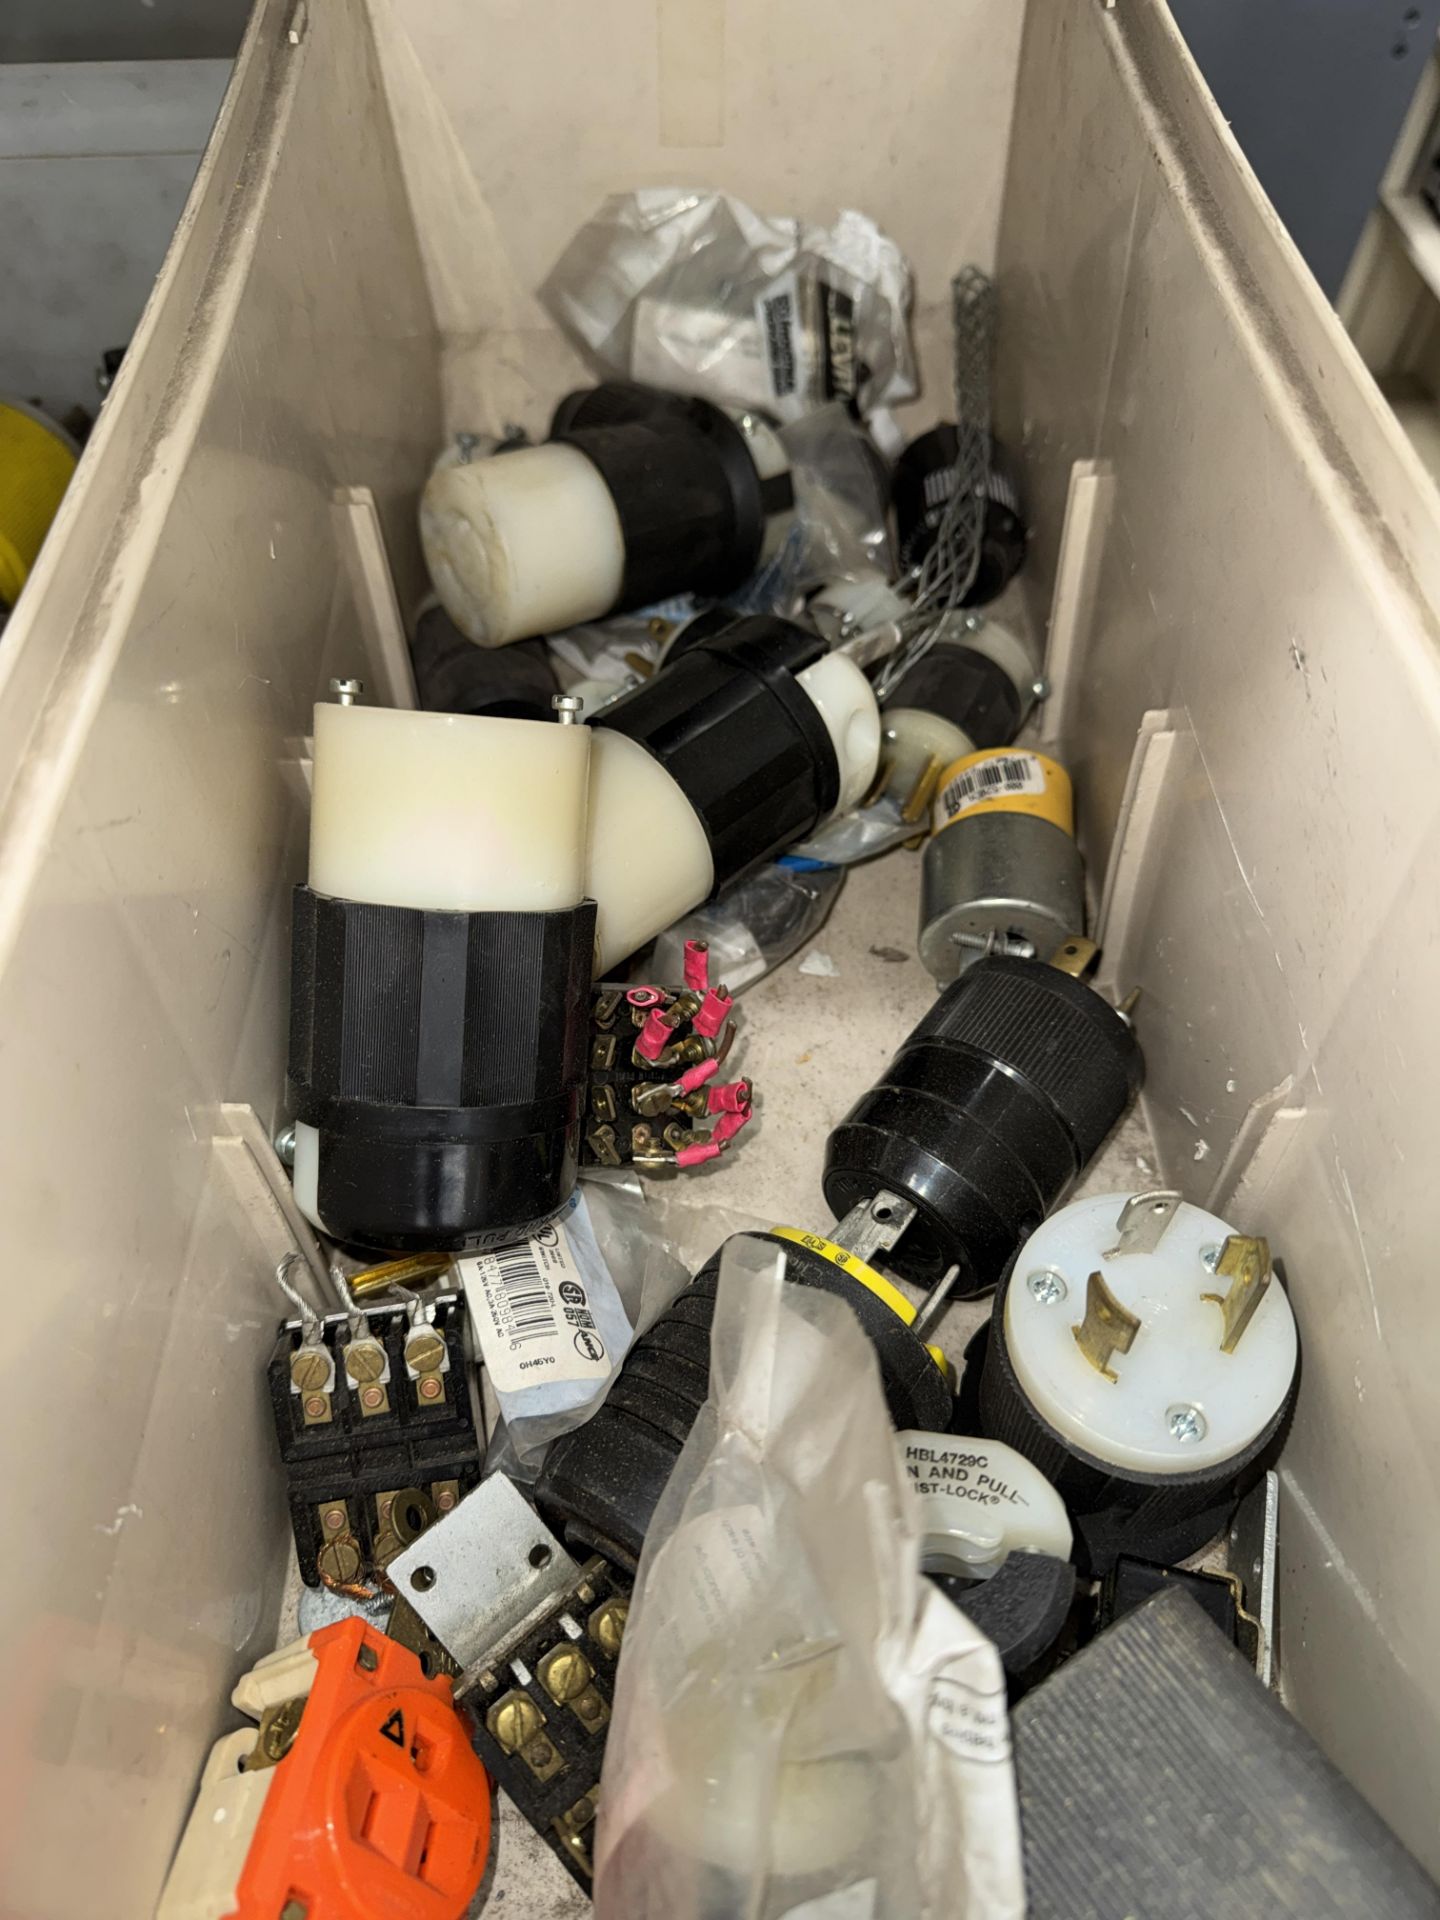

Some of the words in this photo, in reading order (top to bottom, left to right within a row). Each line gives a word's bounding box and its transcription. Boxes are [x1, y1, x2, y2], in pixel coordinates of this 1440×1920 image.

[563, 1307, 580, 1328] 057
[906, 1446, 989, 1469] HBL4729C
[928, 1465, 969, 1481] AND
